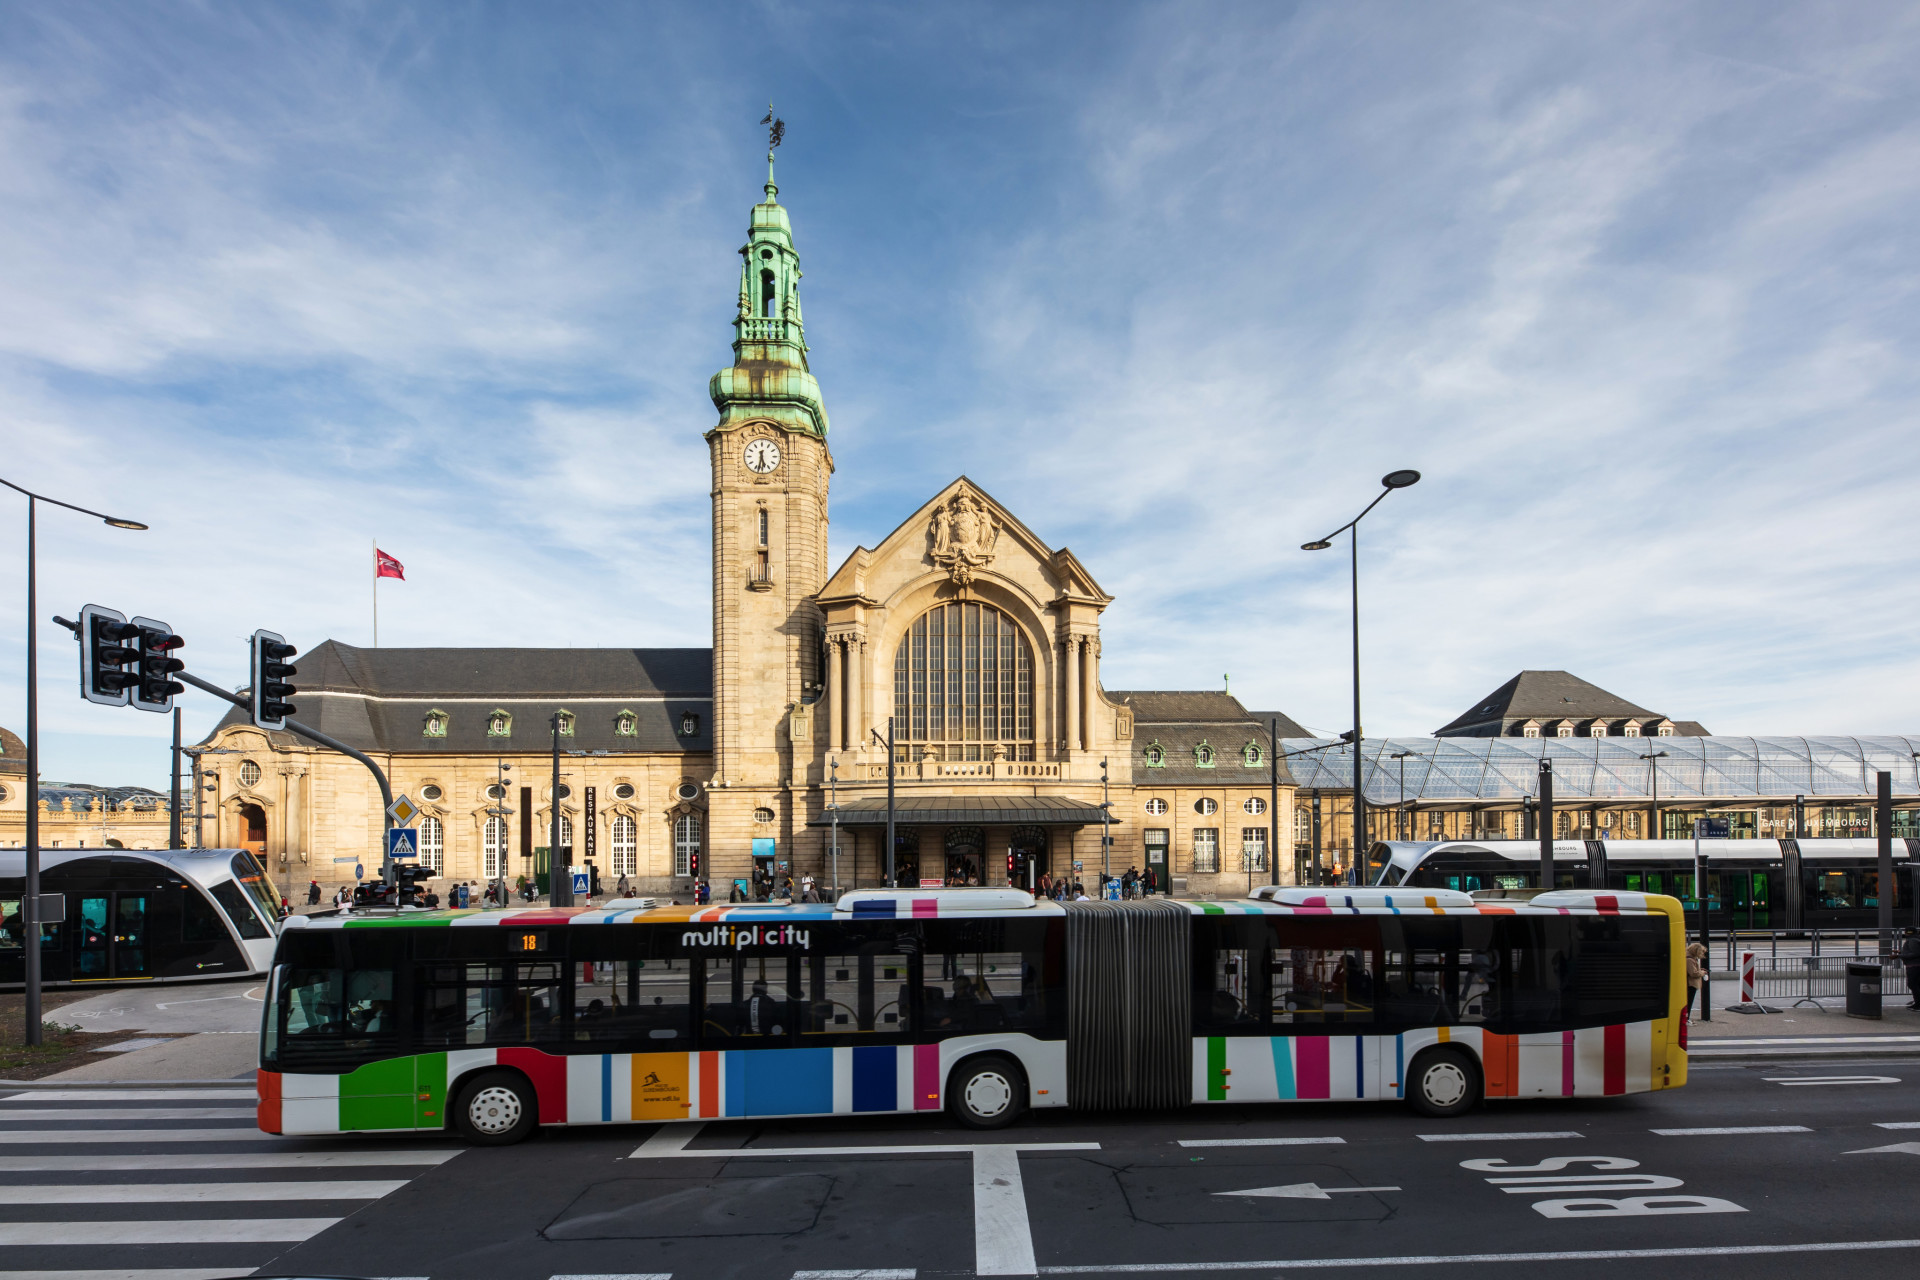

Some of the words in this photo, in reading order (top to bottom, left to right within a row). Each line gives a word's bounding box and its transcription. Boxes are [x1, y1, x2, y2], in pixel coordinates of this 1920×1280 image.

[1762, 818, 1786, 827] GARE
[1806, 818, 1869, 827] UXEMBOURG
[522, 935, 536, 950] 18
[682, 924, 810, 951] multiplicity
[418, 1084, 431, 1092] 611
[1459, 1155, 1750, 1219] BUS
